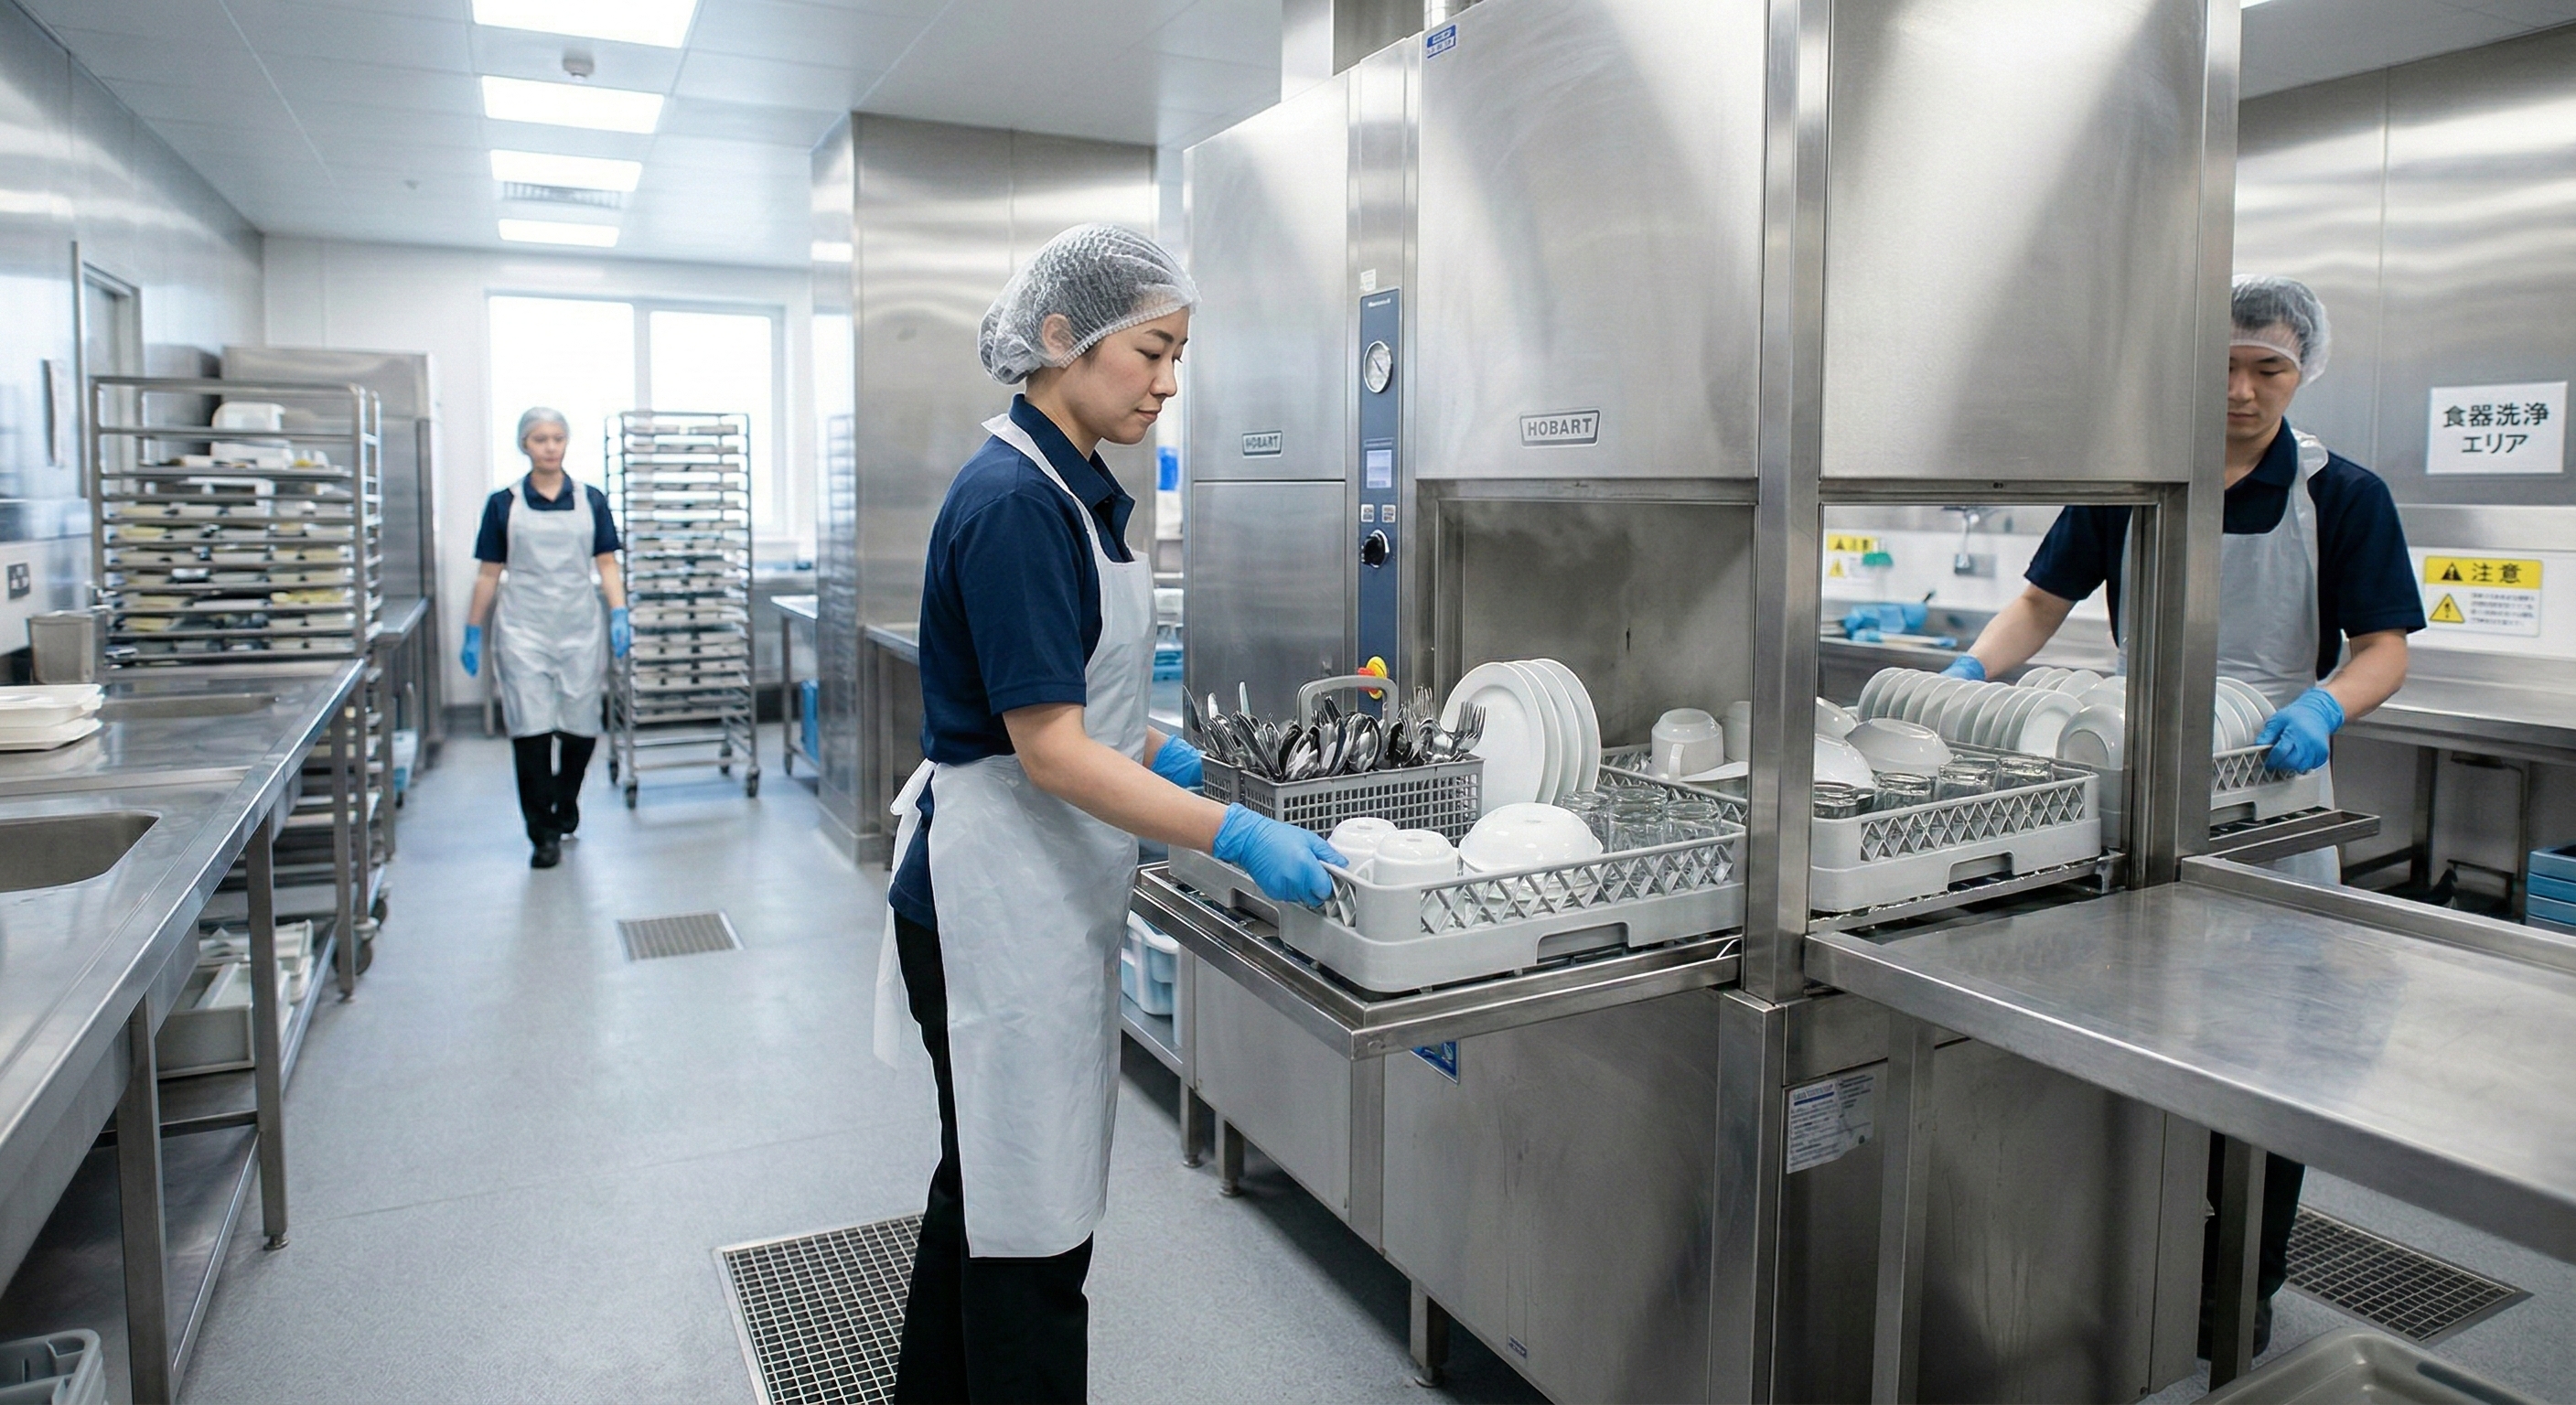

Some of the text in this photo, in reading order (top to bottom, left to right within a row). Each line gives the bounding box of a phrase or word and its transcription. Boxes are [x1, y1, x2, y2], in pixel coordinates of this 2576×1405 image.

[2443, 402, 2549, 427] 食器洗浄
[1528, 418, 1592, 436] HOBART
[2462, 434, 2528, 454] エリア
[2472, 563, 2522, 584] 注意
